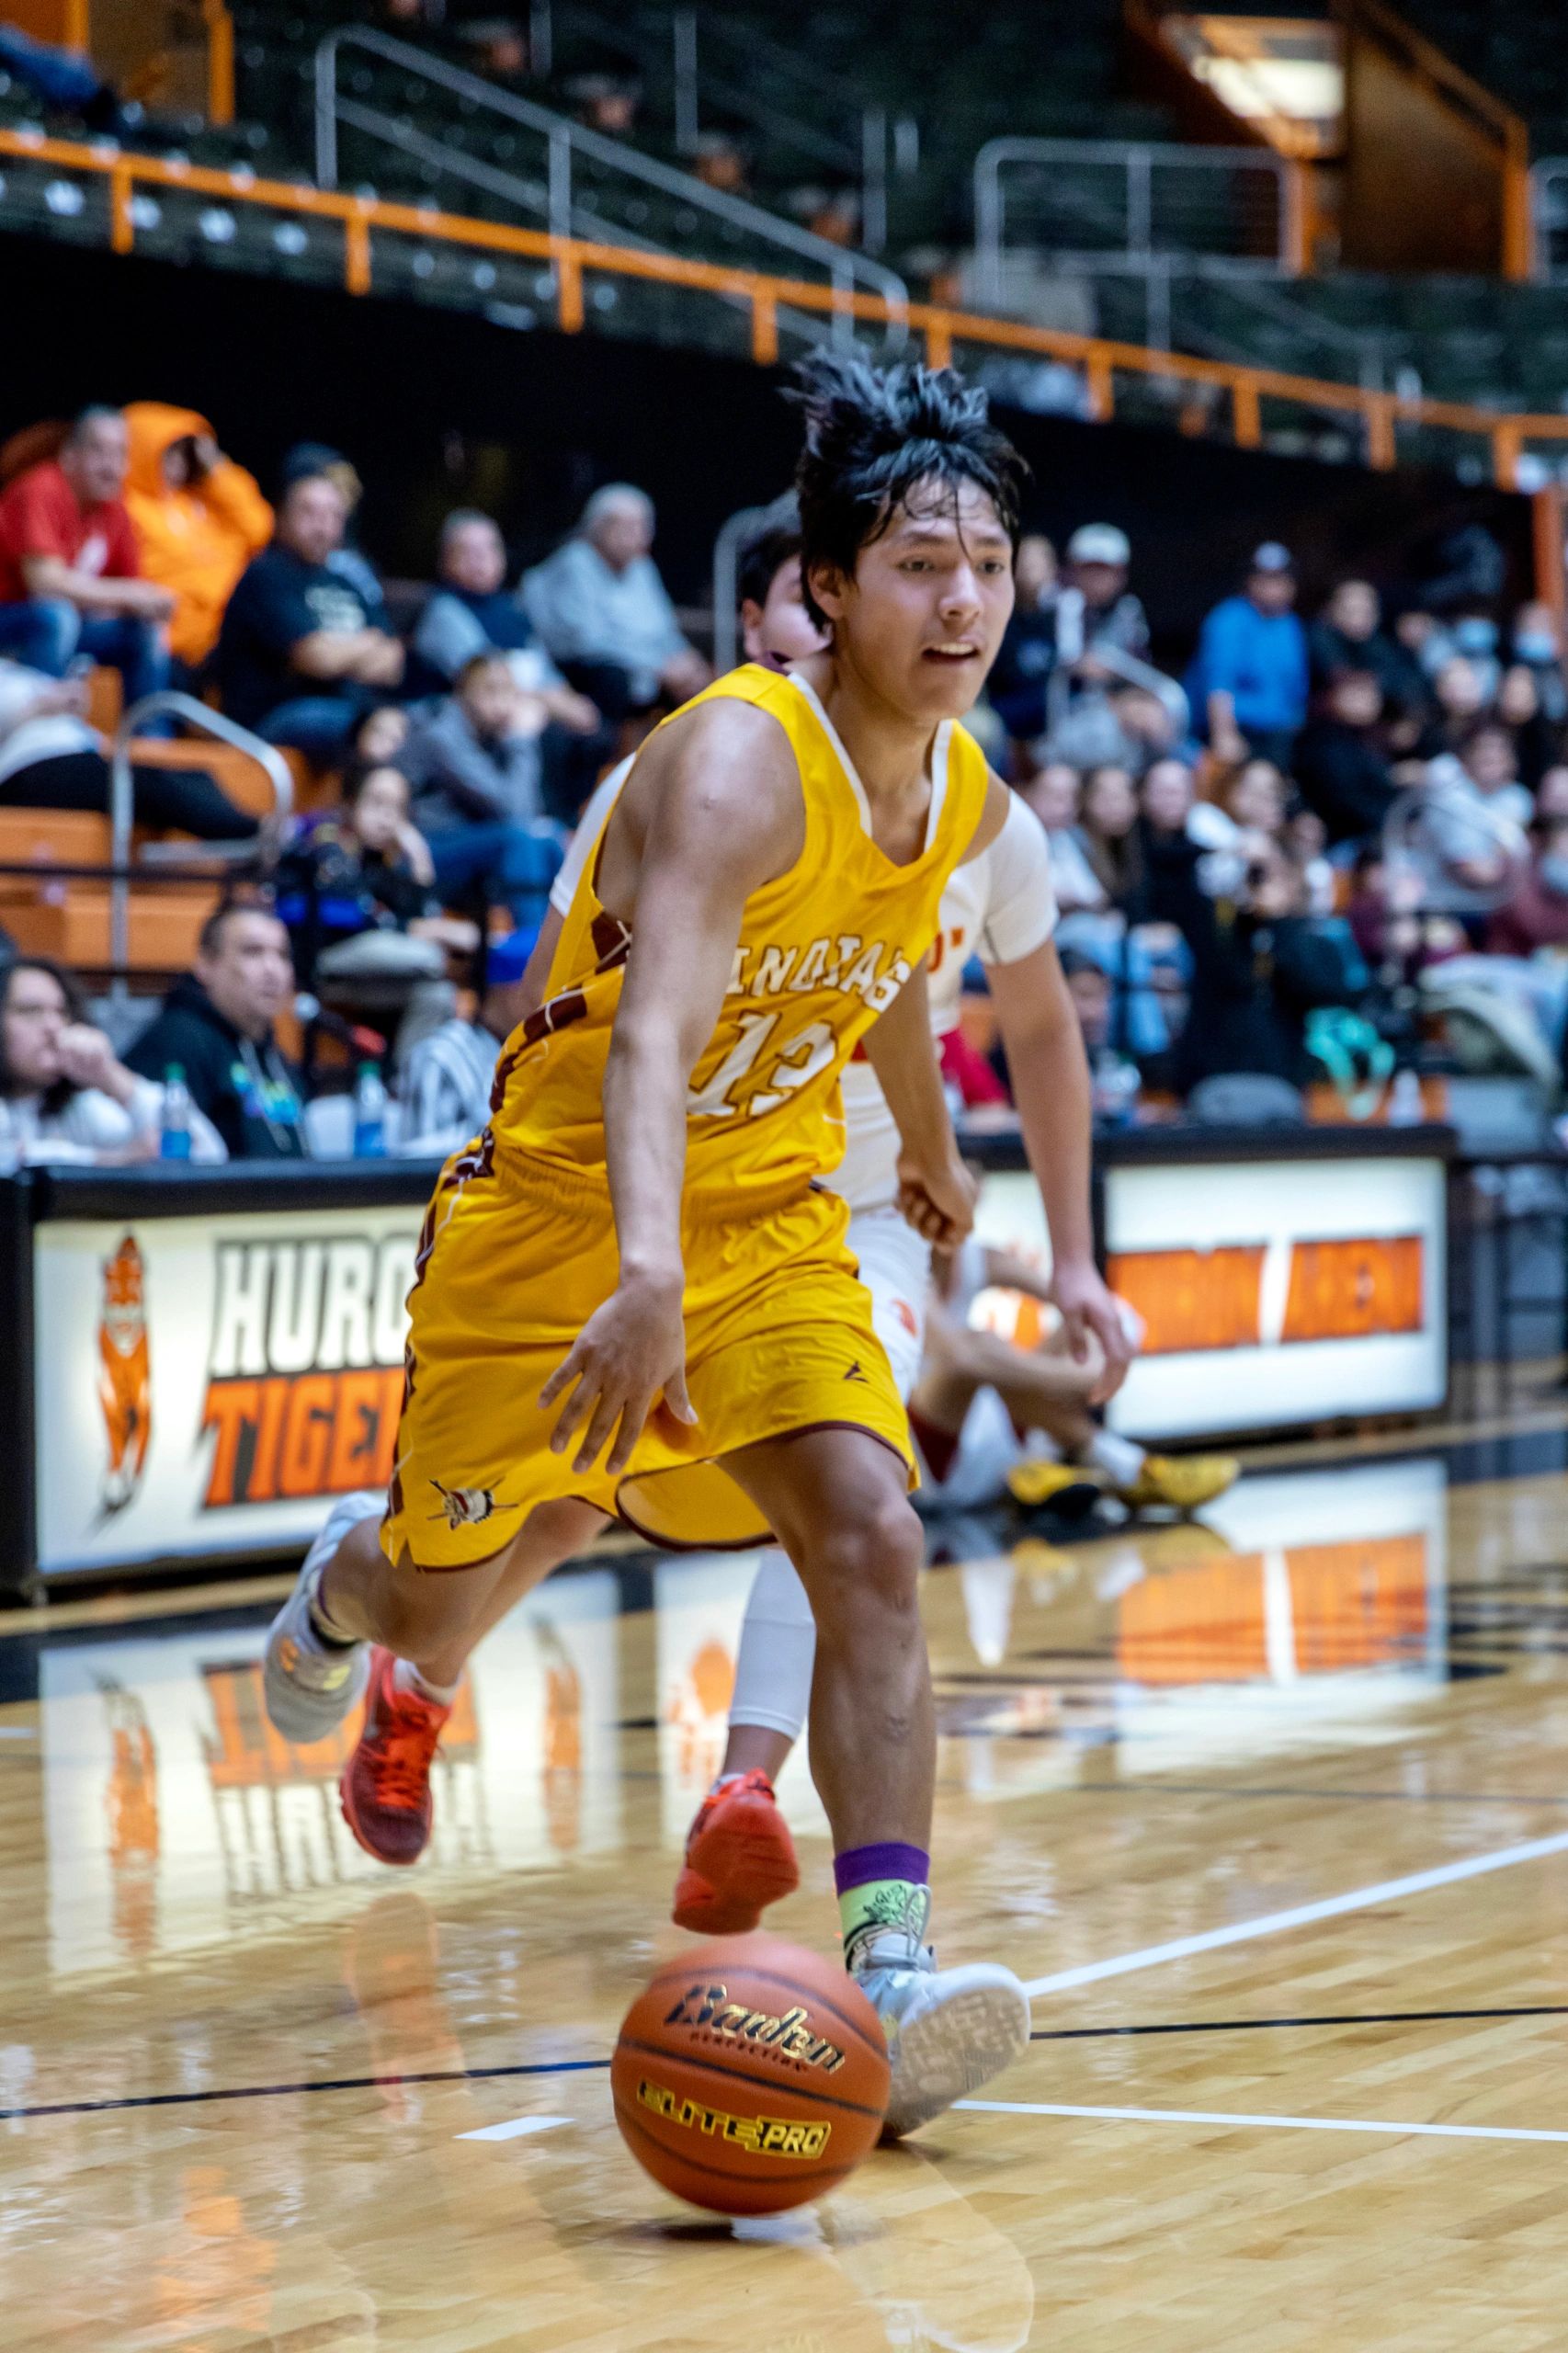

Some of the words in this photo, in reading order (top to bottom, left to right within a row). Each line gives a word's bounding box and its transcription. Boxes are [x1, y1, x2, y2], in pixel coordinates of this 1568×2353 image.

[664, 1984, 846, 2075] Baden
[636, 2077, 759, 2144] ELITE
[760, 2120, 828, 2157] PRO
